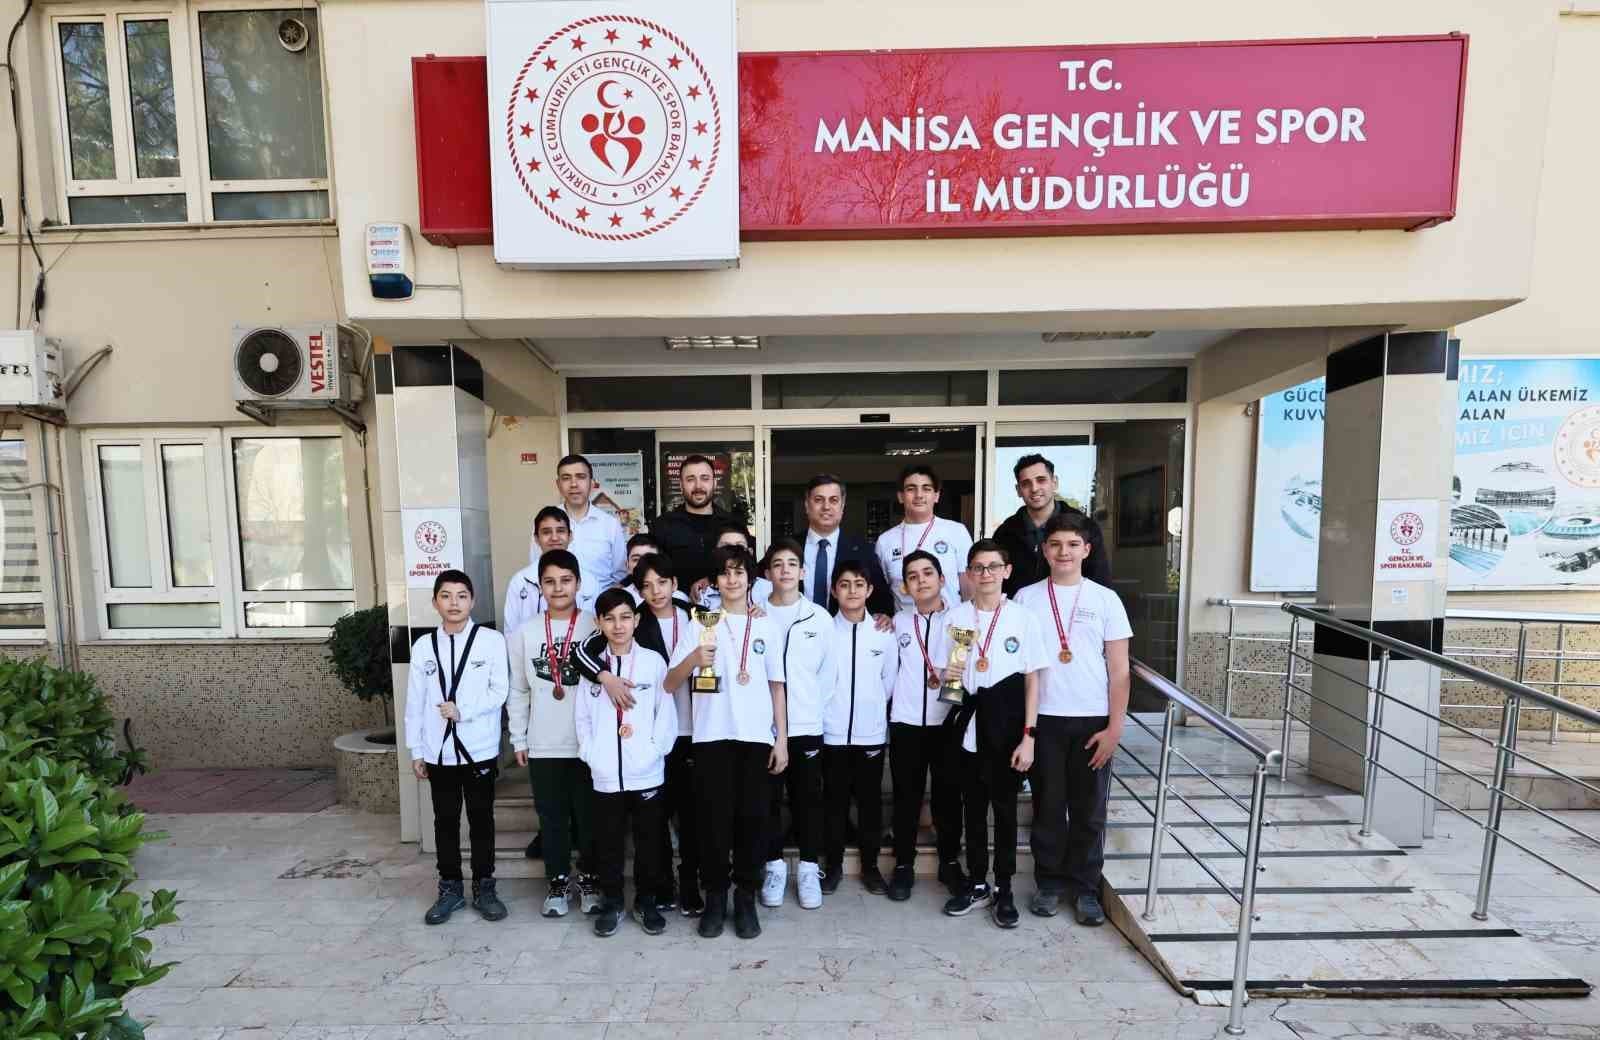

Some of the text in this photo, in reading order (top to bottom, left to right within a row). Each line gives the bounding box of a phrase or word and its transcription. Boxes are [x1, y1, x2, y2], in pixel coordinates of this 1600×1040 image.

[1060, 59, 1122, 91] T.C.
[546, 57, 681, 198] TÜRKİYE CUMHURİYETİ GENÇLİK VE SPOR BAKANLIĞI
[815, 102, 1367, 157] MANİSA GENÇLİK VE SPOR
[926, 163, 1249, 212] İL MÜDÜRLÜĞÜ
[309, 329, 325, 393] VESTEL
[1460, 408, 1505, 420] ALAN
[1466, 390, 1512, 402] ALAN
[1518, 386, 1588, 402] ÜLKEMİZ
